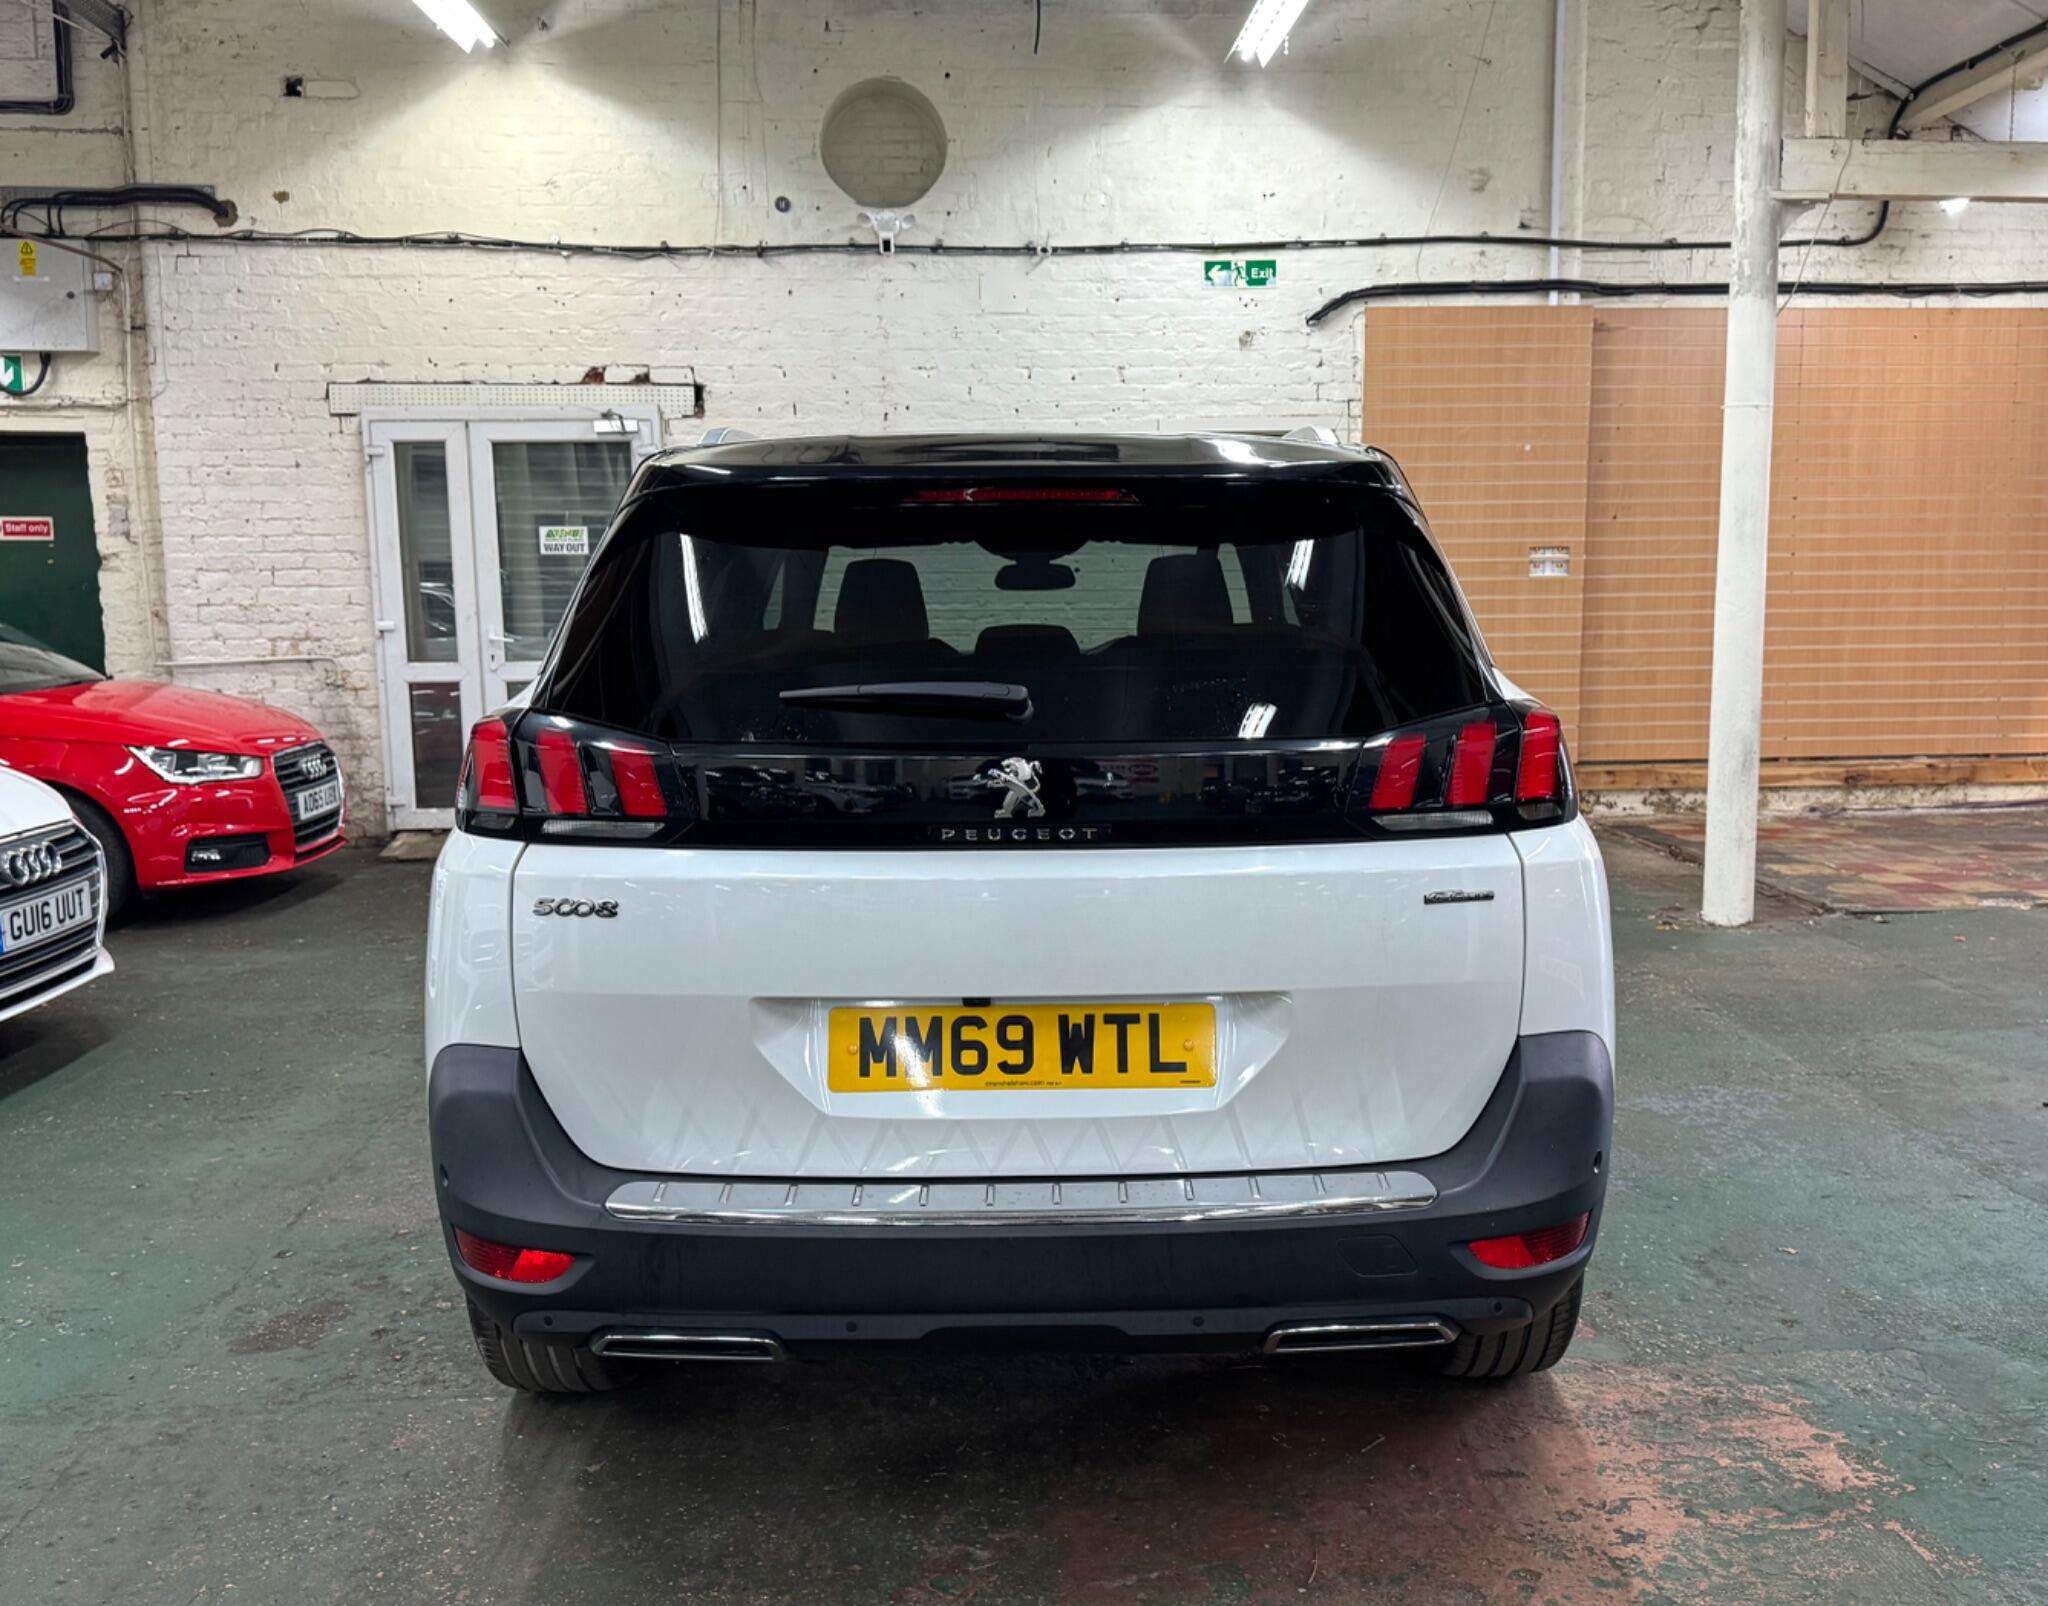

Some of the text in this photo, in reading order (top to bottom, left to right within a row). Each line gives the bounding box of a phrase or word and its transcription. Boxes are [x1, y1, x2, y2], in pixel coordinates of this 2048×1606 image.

[1251, 267, 1273, 279] Exit
[5, 522, 49, 534] Staff only
[544, 543, 585, 552] WAY OUT
[941, 828, 1098, 841] PEUGEOT
[10, 888, 84, 940] GU16 UUT
[532, 897, 619, 918] 5008
[858, 1013, 1188, 1078] MM69 WTL
